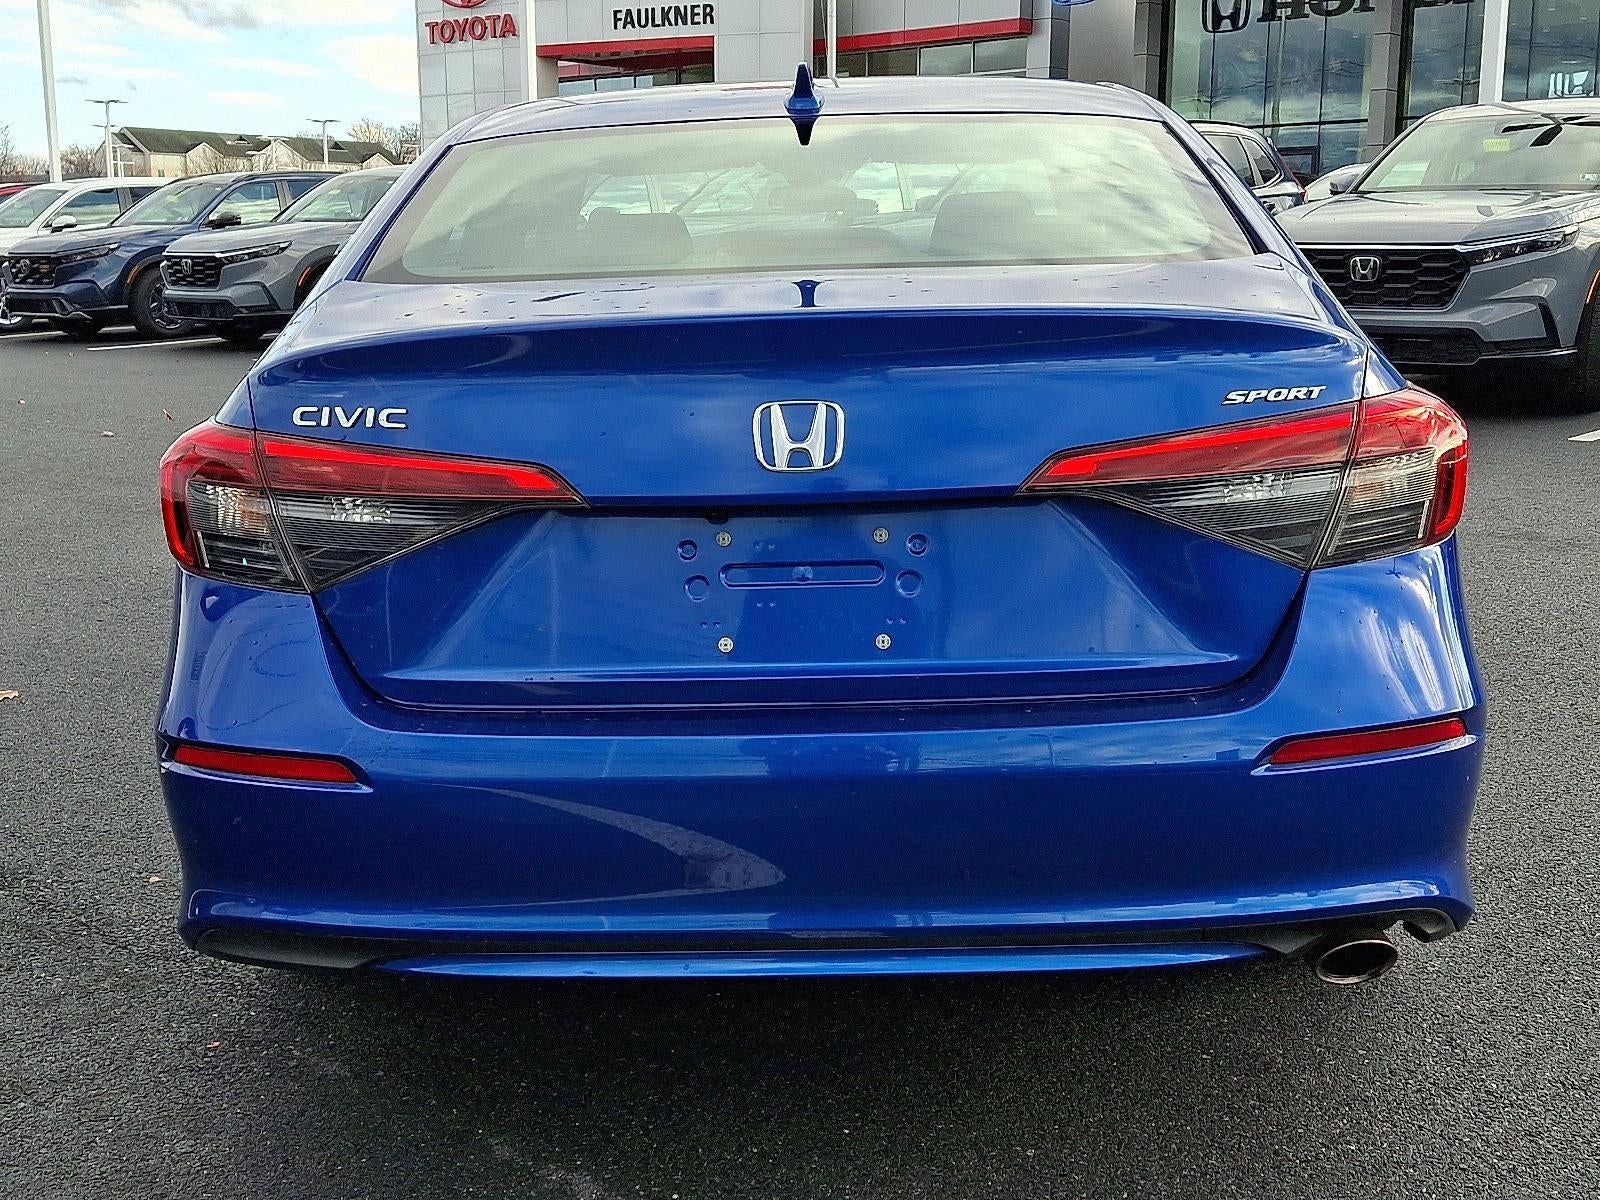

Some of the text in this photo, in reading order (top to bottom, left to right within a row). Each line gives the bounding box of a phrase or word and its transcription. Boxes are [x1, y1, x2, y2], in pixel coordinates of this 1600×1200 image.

[425, 13, 517, 44] TOYOTA
[612, 3, 715, 30] FAULKNER
[1221, 385, 1327, 405] SPORT
[292, 406, 408, 428] CIVIC
